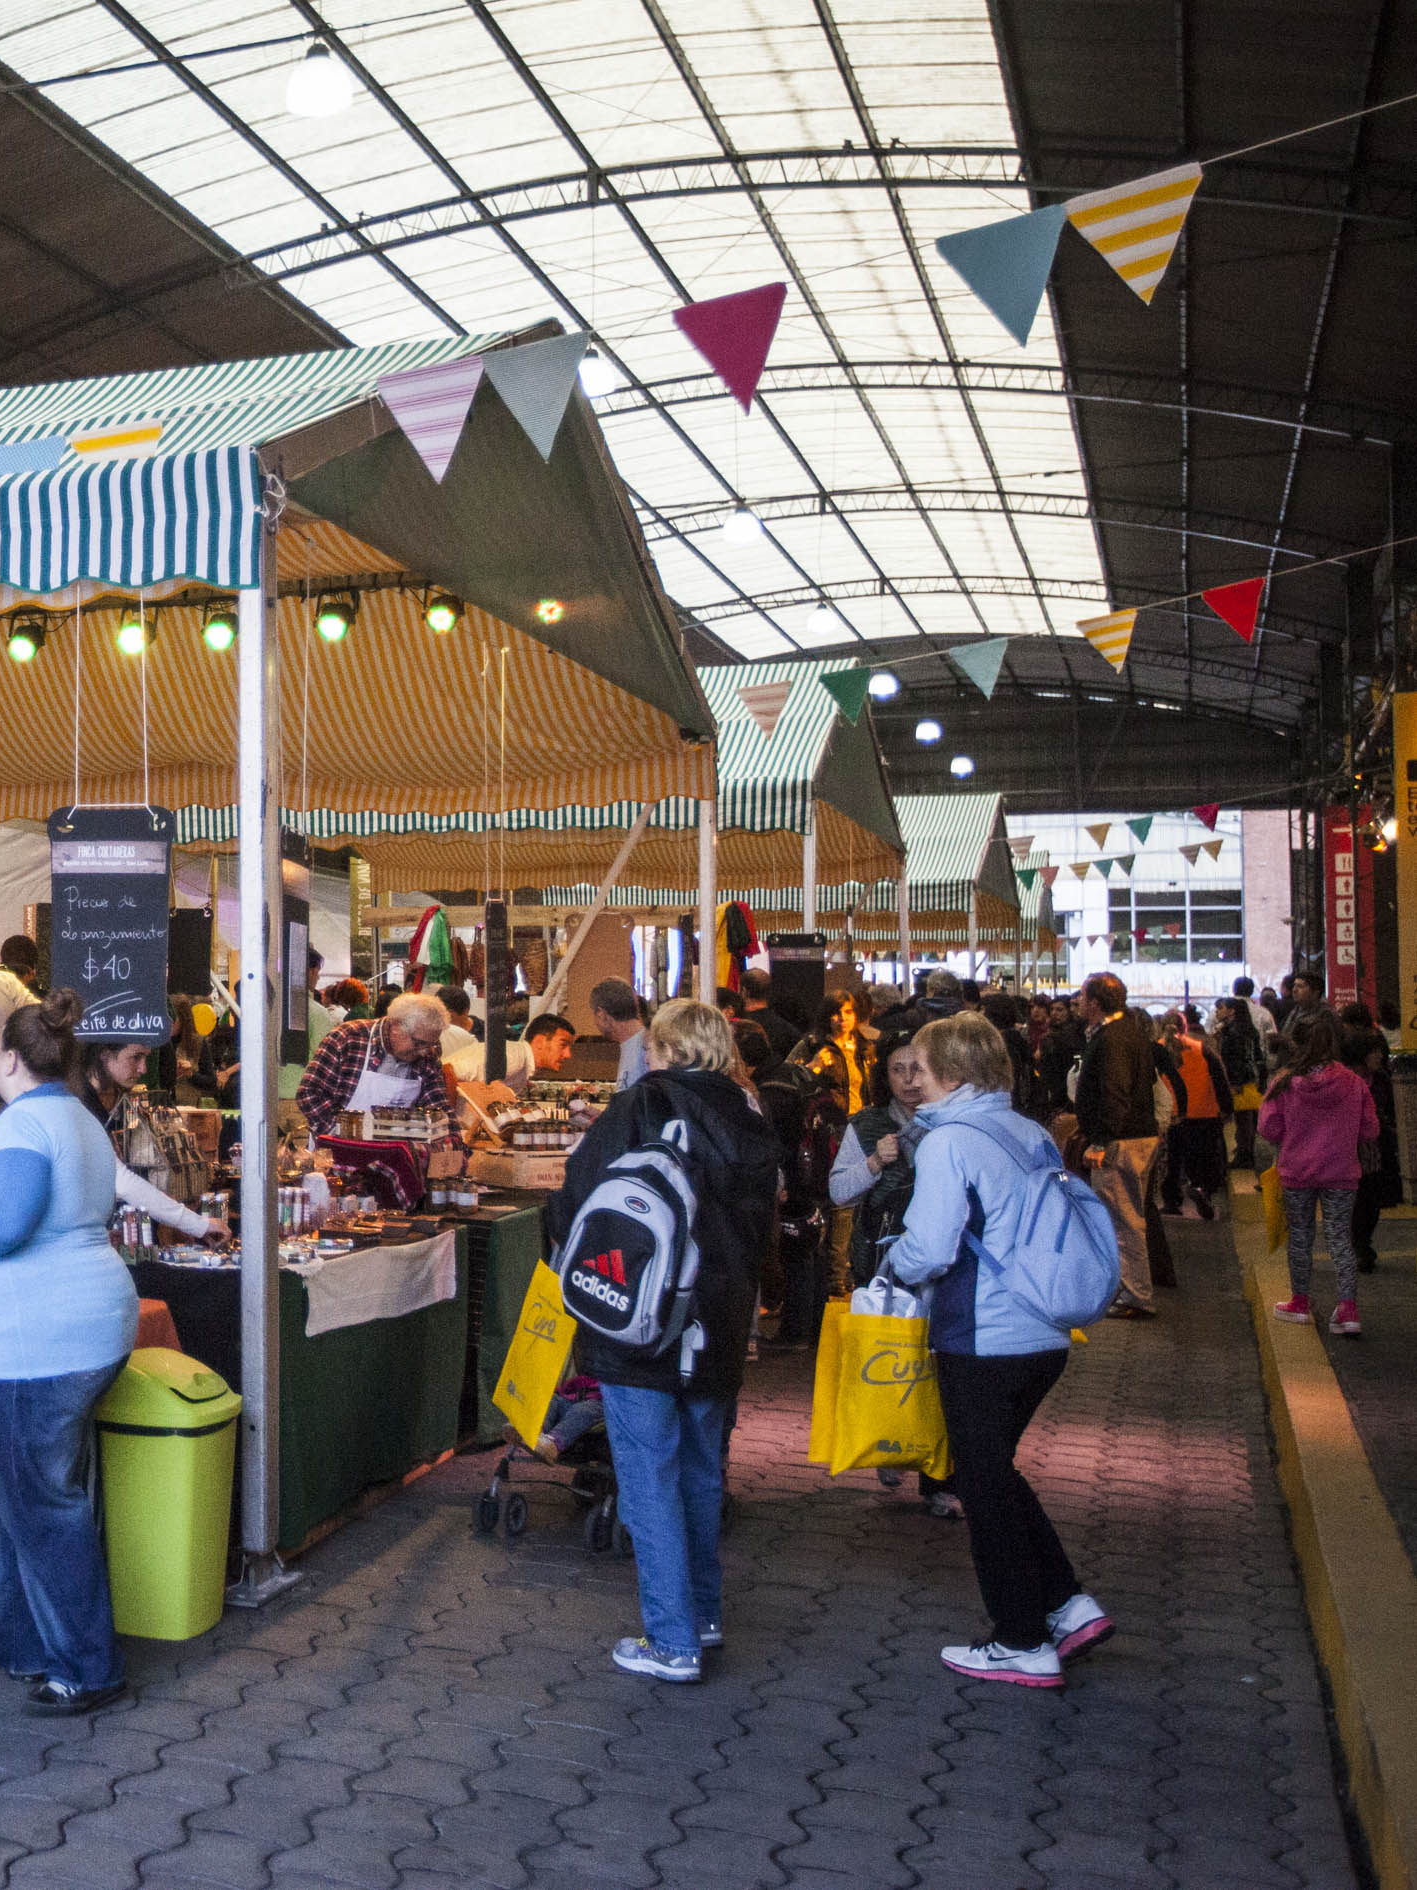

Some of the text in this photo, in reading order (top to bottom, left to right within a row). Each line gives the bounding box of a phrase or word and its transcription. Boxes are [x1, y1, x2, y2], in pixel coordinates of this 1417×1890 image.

[82, 947, 131, 984] $40
[73, 1012, 164, 1030] eite de oliva
[571, 1270, 630, 1312] adidas
